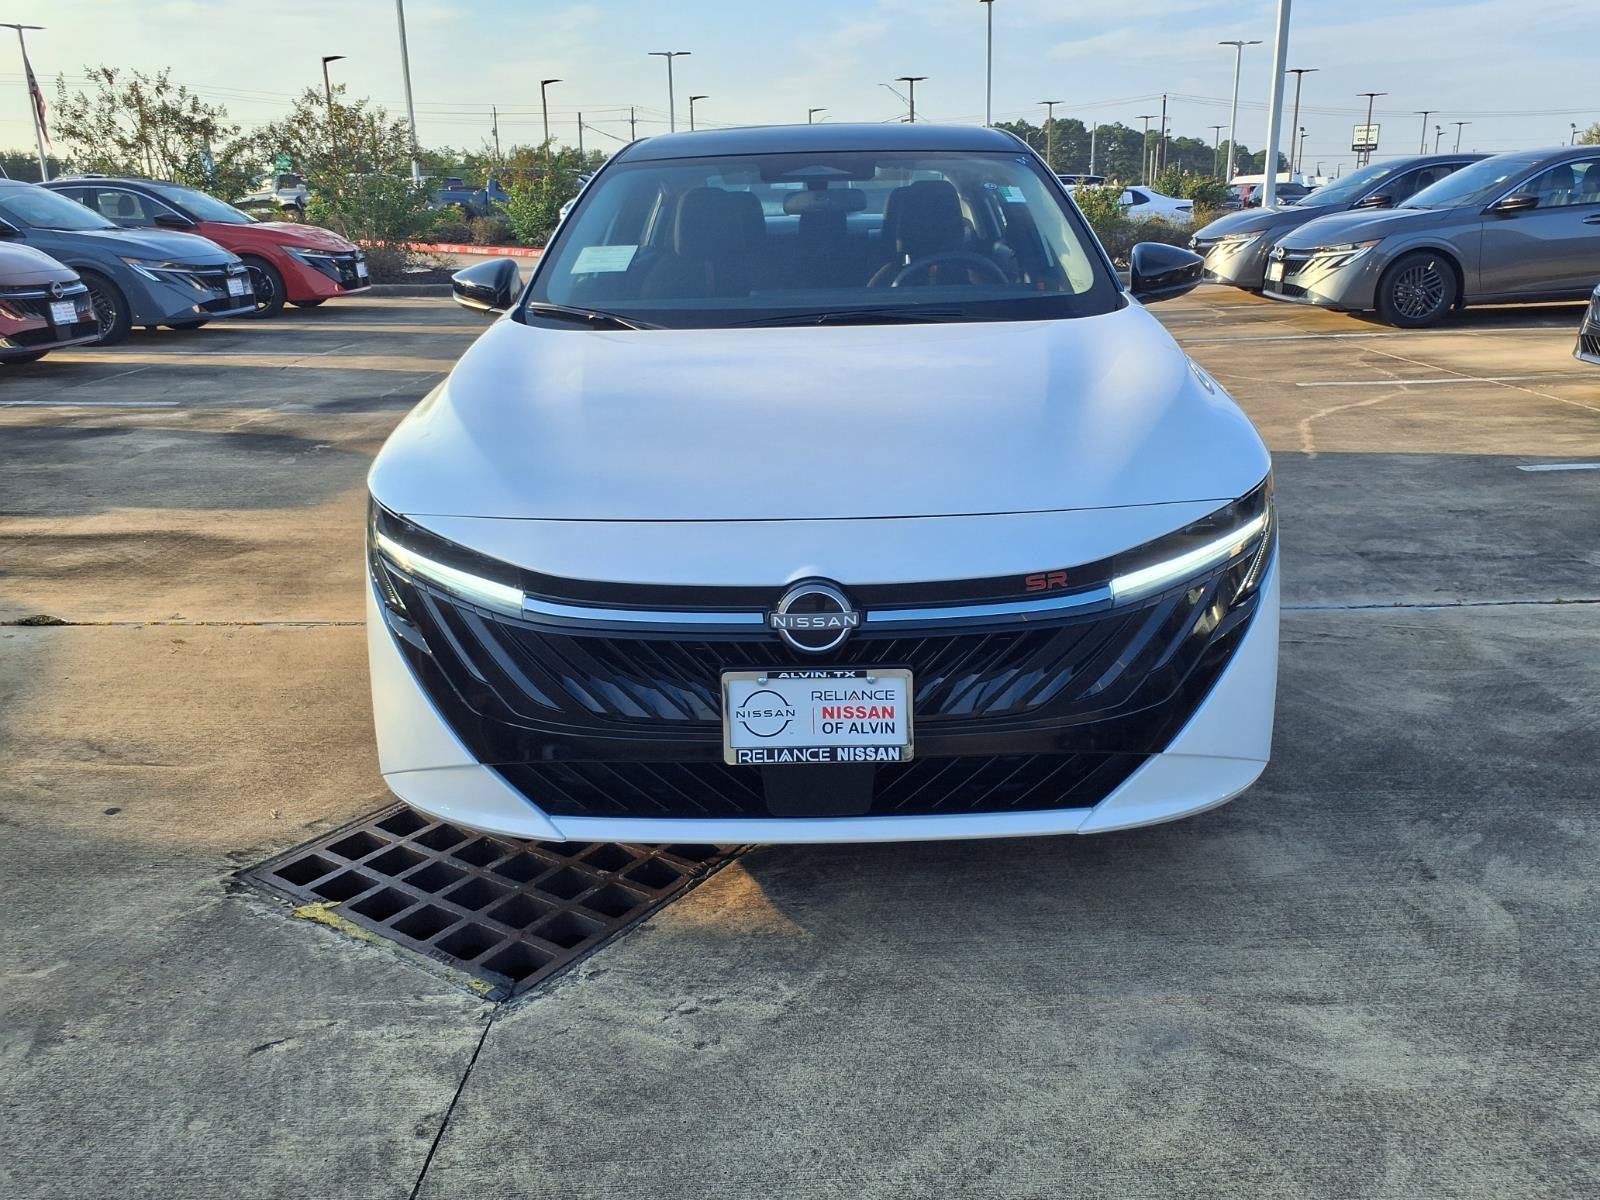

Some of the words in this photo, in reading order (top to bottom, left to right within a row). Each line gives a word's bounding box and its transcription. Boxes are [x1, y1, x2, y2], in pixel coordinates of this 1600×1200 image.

[1025, 571, 1068, 592] SR
[773, 615, 857, 628] NISSAN
[834, 671, 856, 679] TX
[811, 690, 895, 701] RELIANCE
[736, 705, 796, 719] NISSAN
[822, 705, 895, 720] NISSAN
[822, 722, 844, 735] OF
[848, 721, 895, 735] ALVIN
[738, 747, 831, 764] RELIANCE
[837, 747, 900, 761] NISSAN
